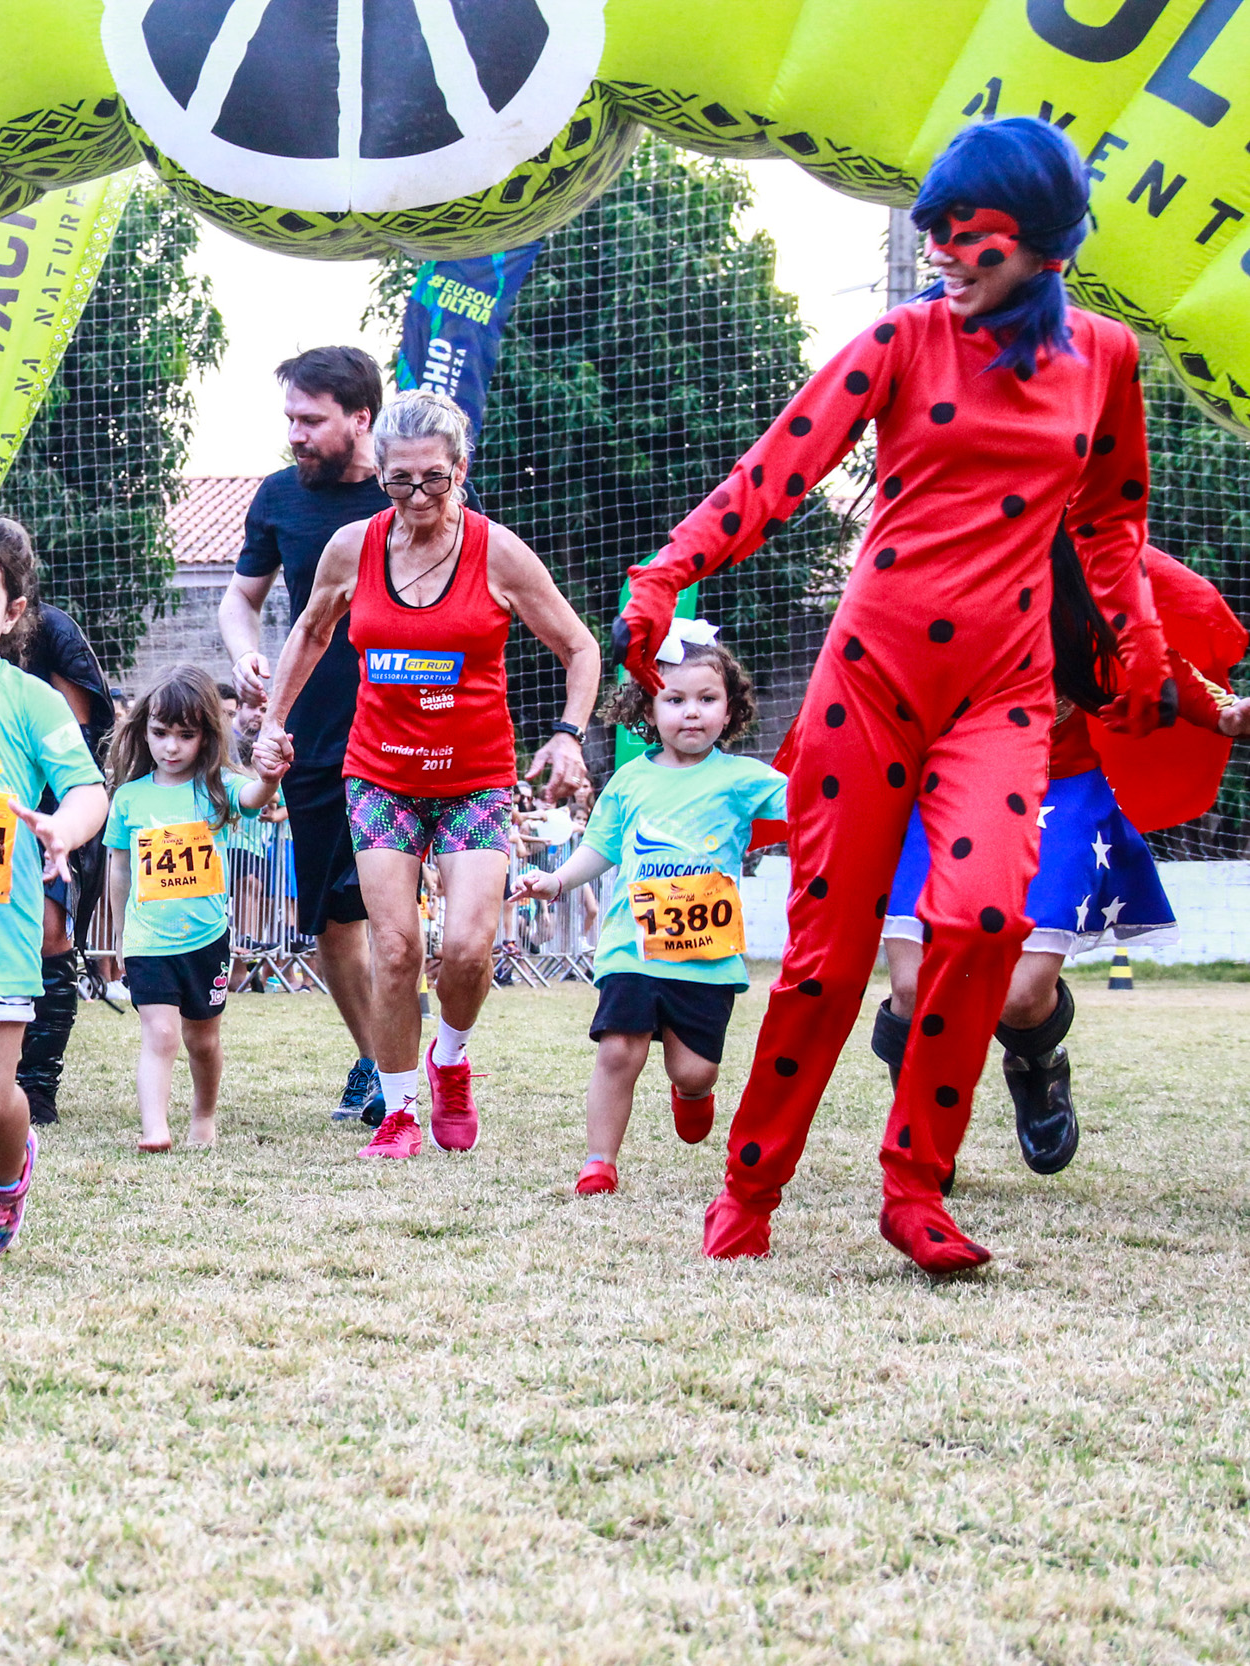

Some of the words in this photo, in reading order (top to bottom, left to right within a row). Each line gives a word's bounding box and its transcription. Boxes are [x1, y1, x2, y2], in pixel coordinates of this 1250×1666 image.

[427, 274, 498, 310] #EUSOU
[437, 292, 493, 326] ULTRA
[370, 653, 410, 671] MT
[407, 661, 425, 669] FIT
[426, 661, 452, 670] RUN
[410, 673, 452, 681] ESPORTIVA
[419, 693, 454, 708] paixão
[381, 742, 415, 756] Corrida
[415, 746, 430, 757] de
[421, 758, 452, 771] 2011
[141, 844, 214, 876] 1417
[160, 876, 197, 888] SARAH
[638, 899, 733, 936] 1380
[664, 935, 714, 951] MARIAH
